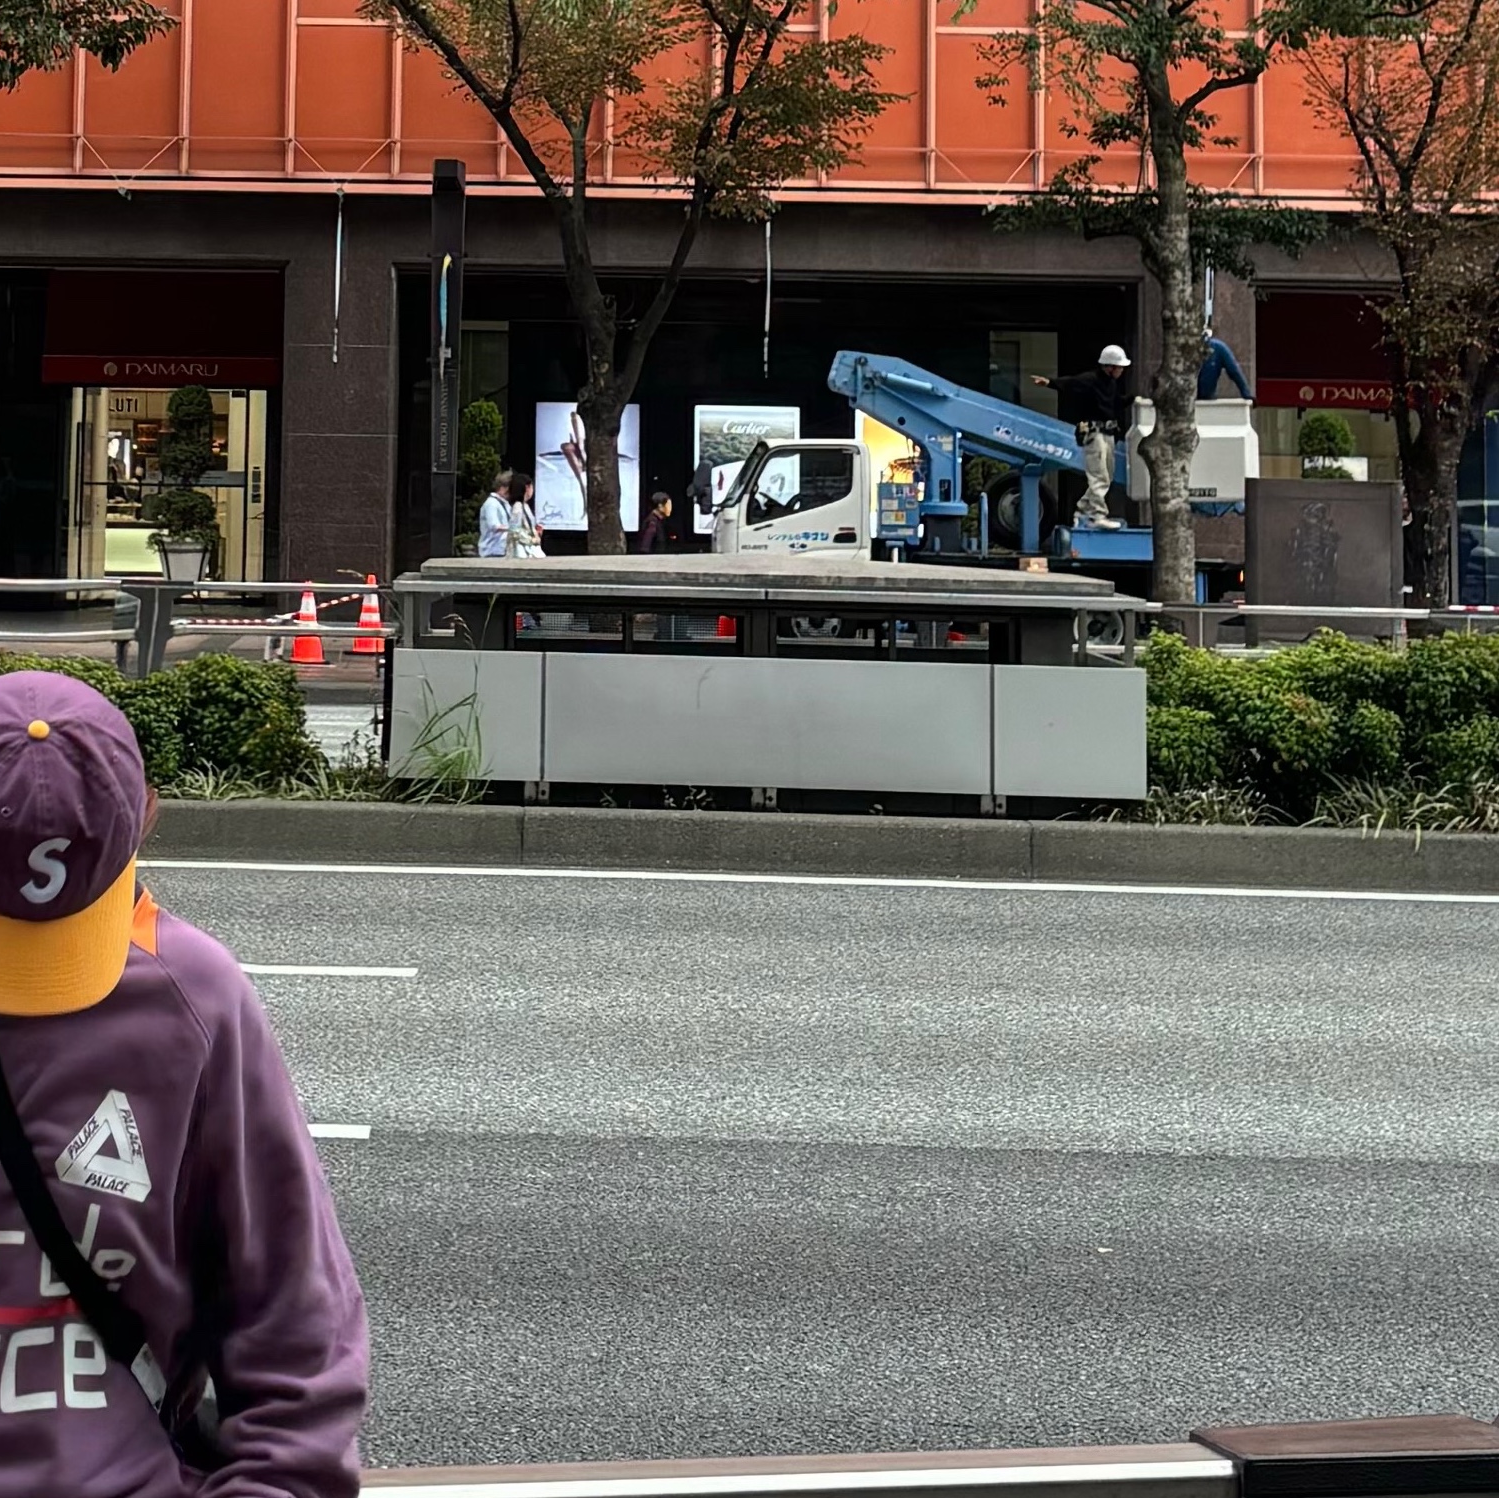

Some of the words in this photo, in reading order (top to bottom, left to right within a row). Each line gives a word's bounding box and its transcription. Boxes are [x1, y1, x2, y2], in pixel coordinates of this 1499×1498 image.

[126, 363, 219, 377] DAIMARU
[1322, 386, 1387, 400] DAIMA
[723, 419, 771, 435] Cartier
[19, 837, 71, 904] S
[68, 1116, 99, 1160] PALACE
[119, 1108, 143, 1159] PALACE
[85, 1172, 130, 1194] PALACE
